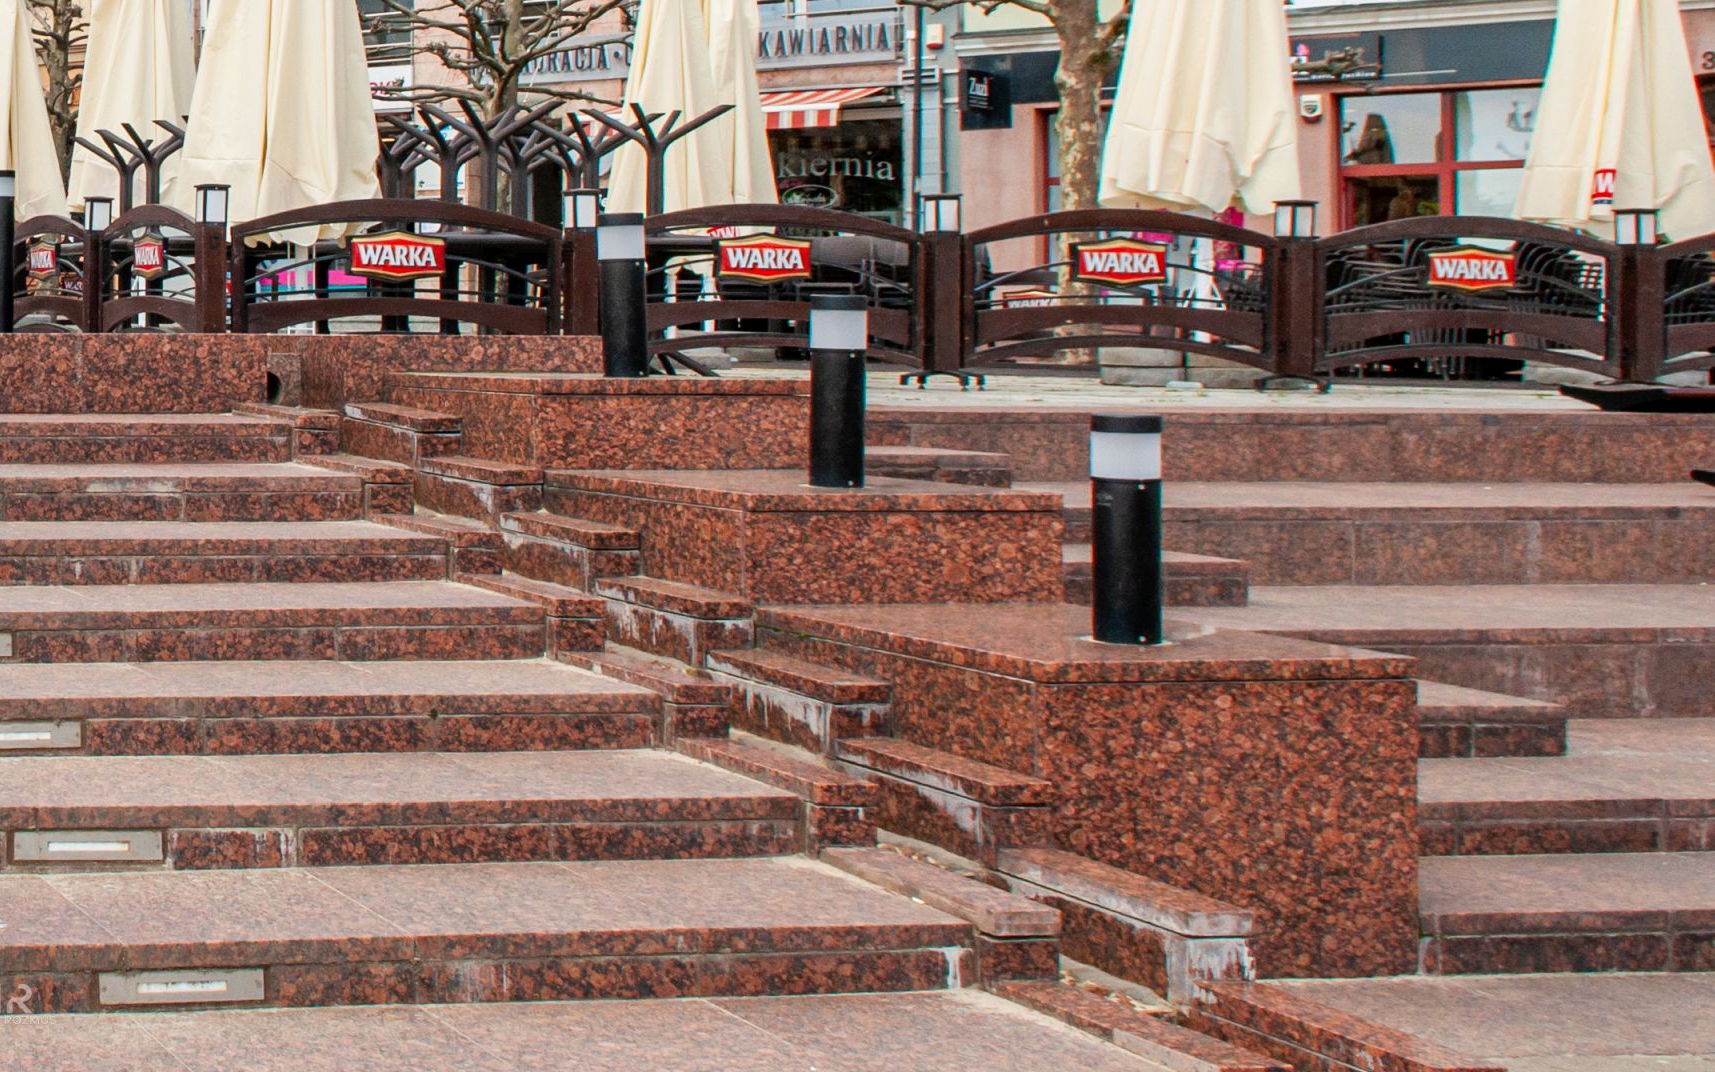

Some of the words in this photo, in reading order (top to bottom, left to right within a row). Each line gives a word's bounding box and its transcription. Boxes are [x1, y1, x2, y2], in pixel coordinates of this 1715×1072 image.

[758, 22, 889, 59] KAWIARNIA
[135, 246, 160, 266] WARKA
[358, 243, 437, 267] WARKA
[726, 247, 804, 269] WARKA
[1083, 251, 1161, 274] WARKA
[1433, 258, 1509, 281] WARKA
